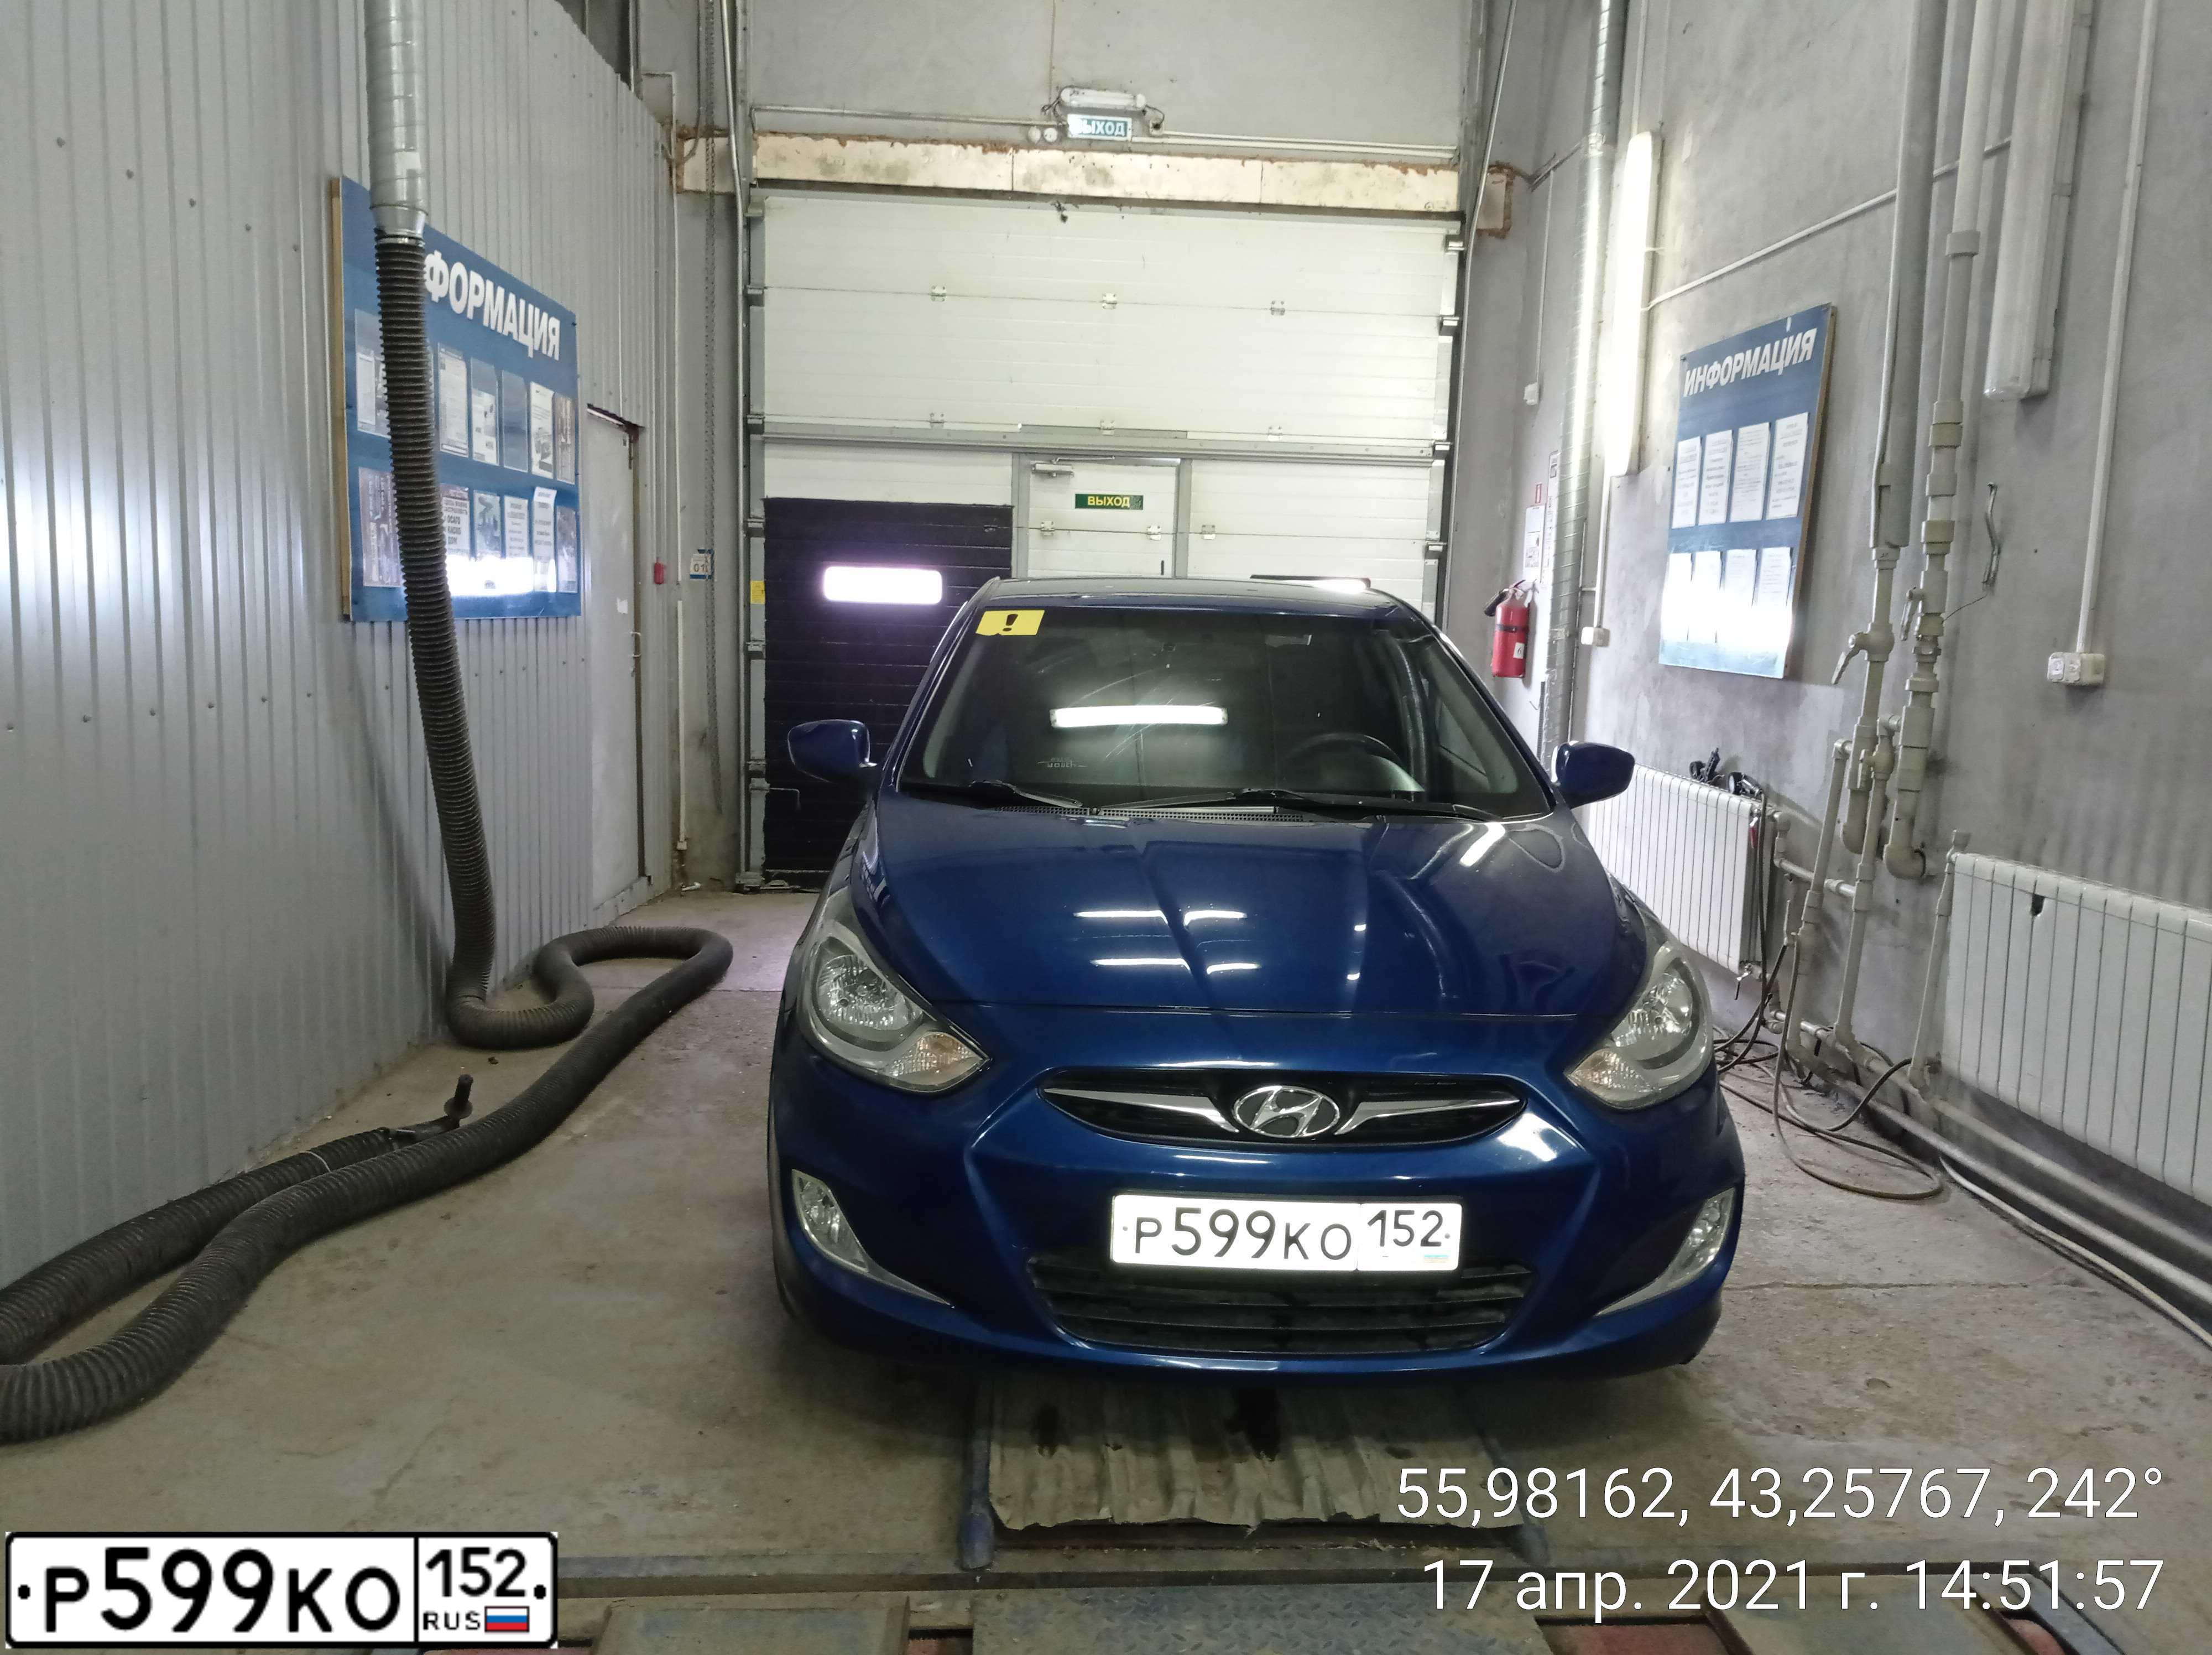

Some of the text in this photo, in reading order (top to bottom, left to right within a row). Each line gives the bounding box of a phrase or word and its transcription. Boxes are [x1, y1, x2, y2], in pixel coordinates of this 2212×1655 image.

[1073, 118, 1125, 136] ЫХОД
[424, 249, 561, 361] ФОРМАЦИЯ
[1683, 327, 1817, 398] ИНФОРМАЦИЯ
[1087, 496, 1130, 508] ВЫХОД
[1135, 1207, 1443, 1261] Р599КО 152
